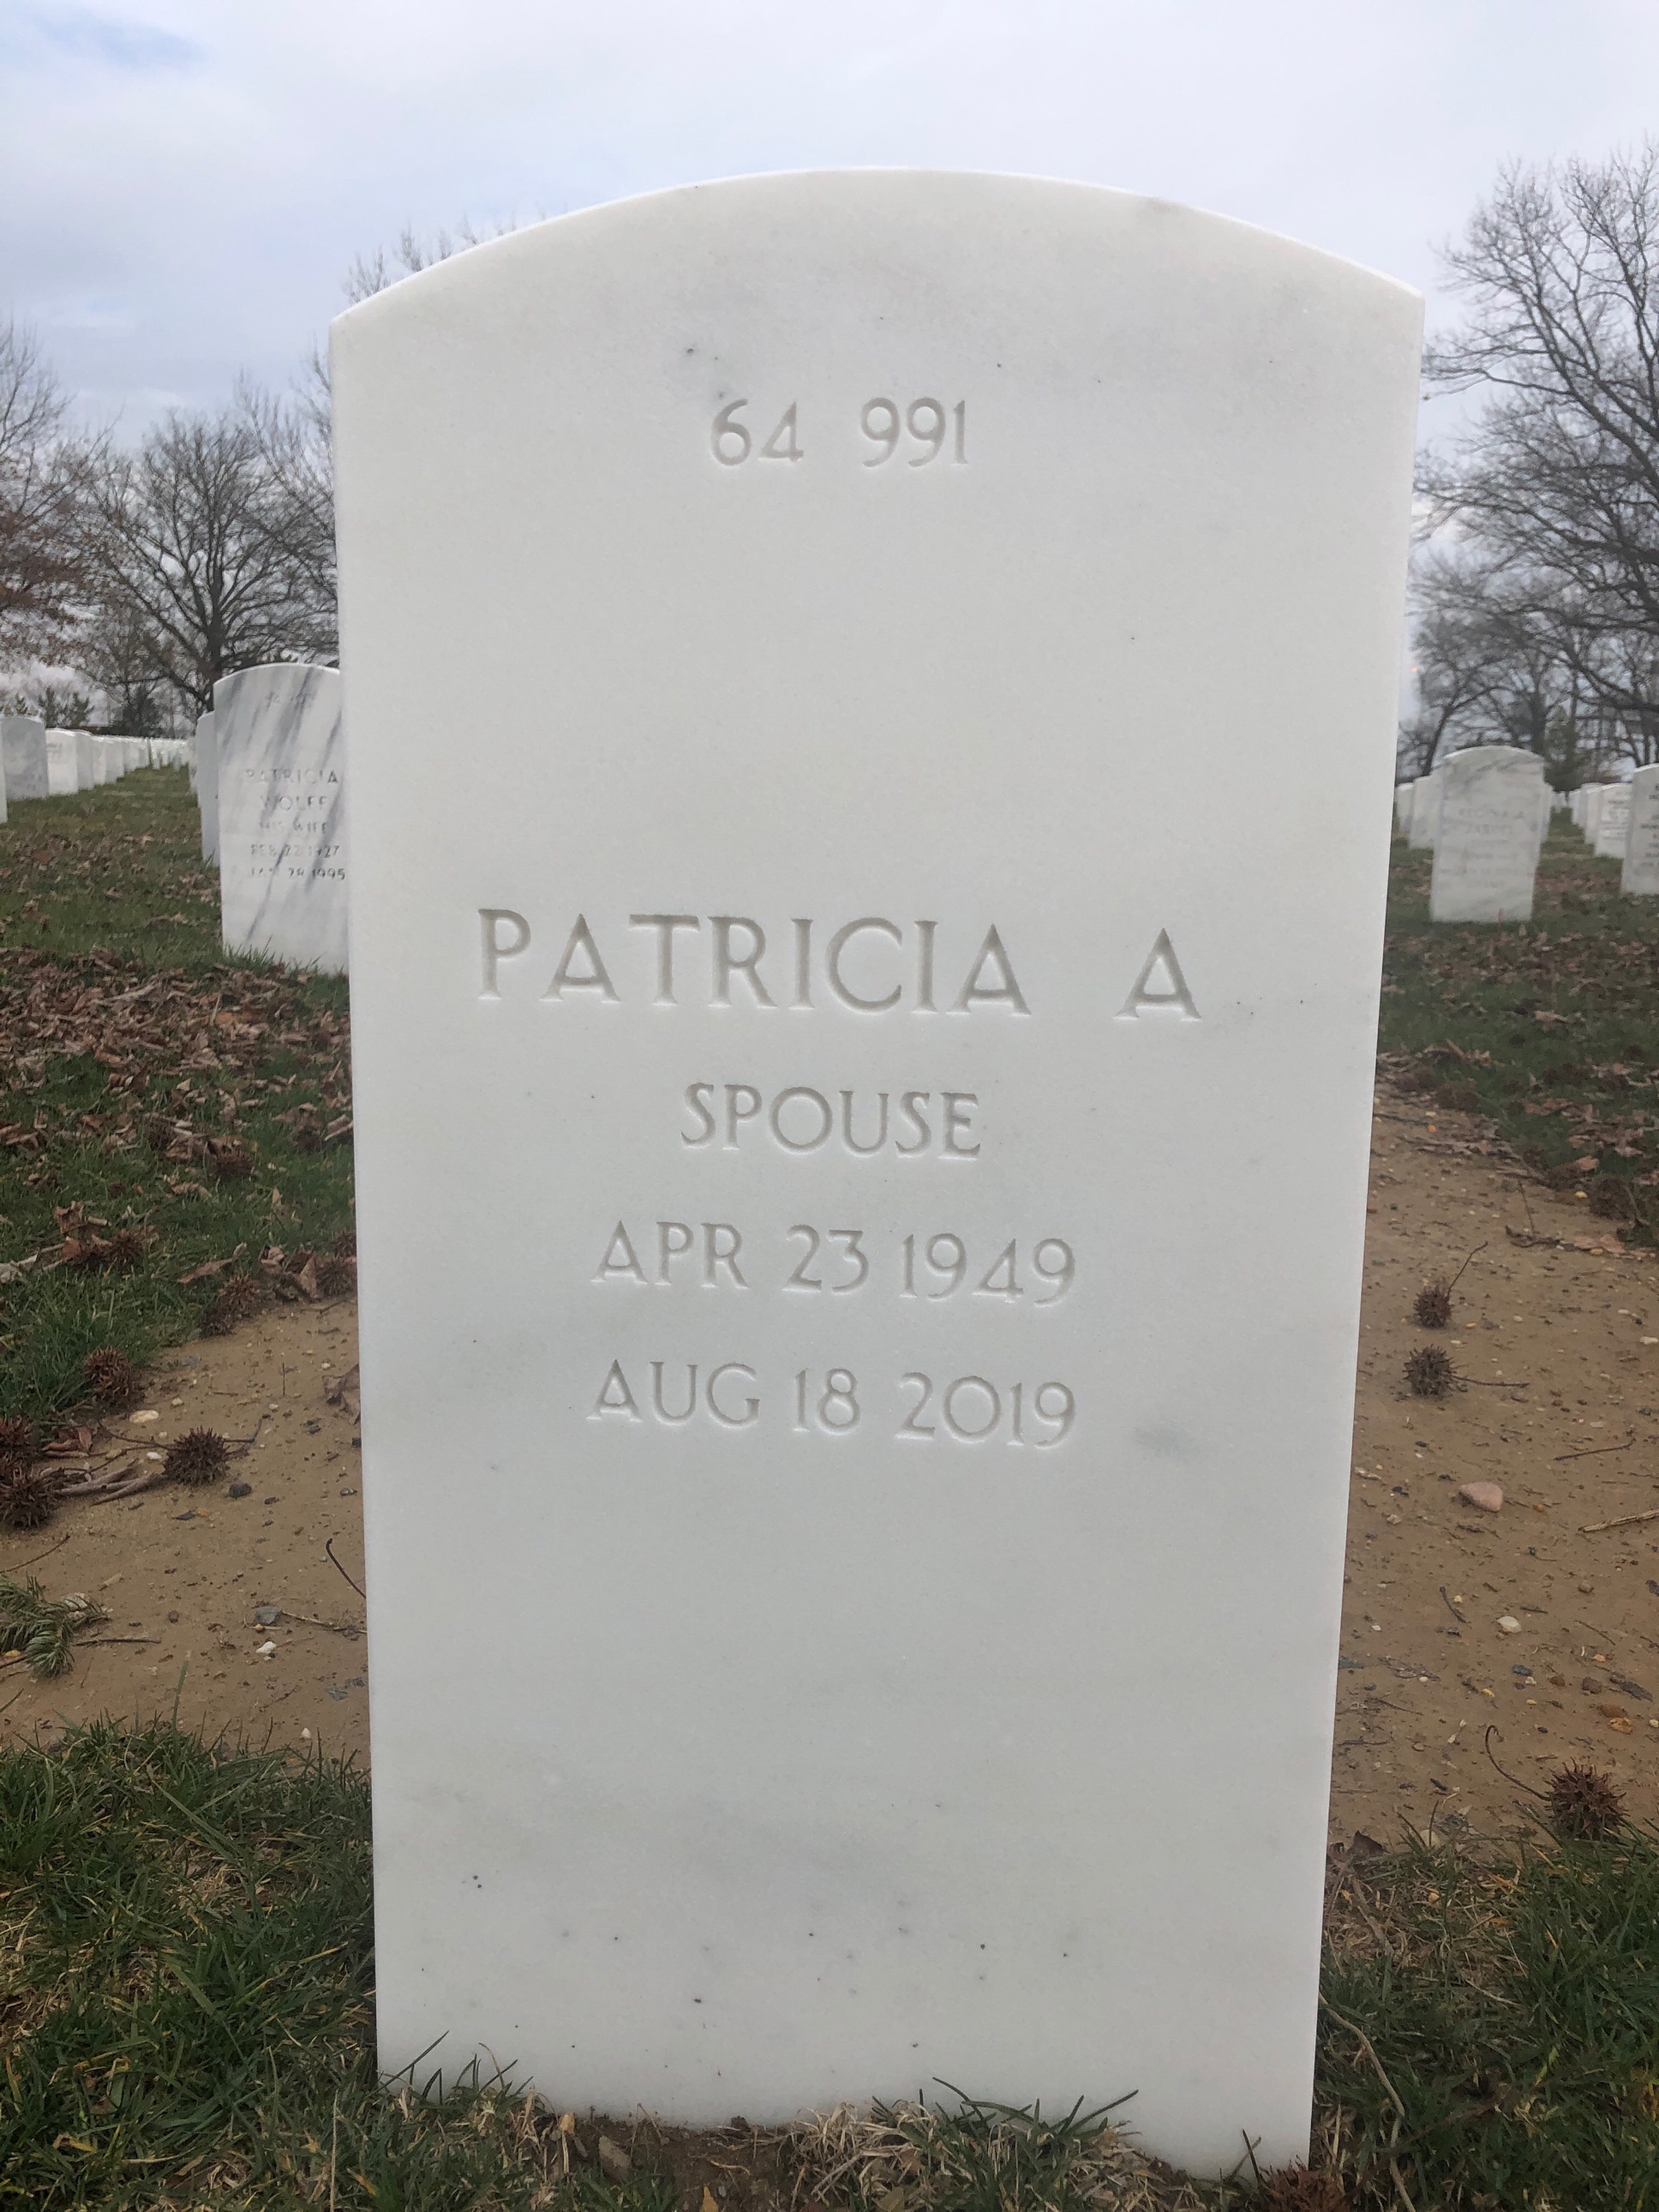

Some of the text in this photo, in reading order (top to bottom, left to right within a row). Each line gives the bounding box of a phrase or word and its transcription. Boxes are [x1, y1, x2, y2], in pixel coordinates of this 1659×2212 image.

[710, 396, 968, 468] 64 991
[246, 768, 339, 784] PATRICIA
[477, 908, 1203, 1022] PATRICIA A
[681, 1082, 981, 1160] SPOUSE
[590, 1220, 1076, 1307] APR 23 1949
[586, 1359, 1077, 1449] AUG 18 2019
